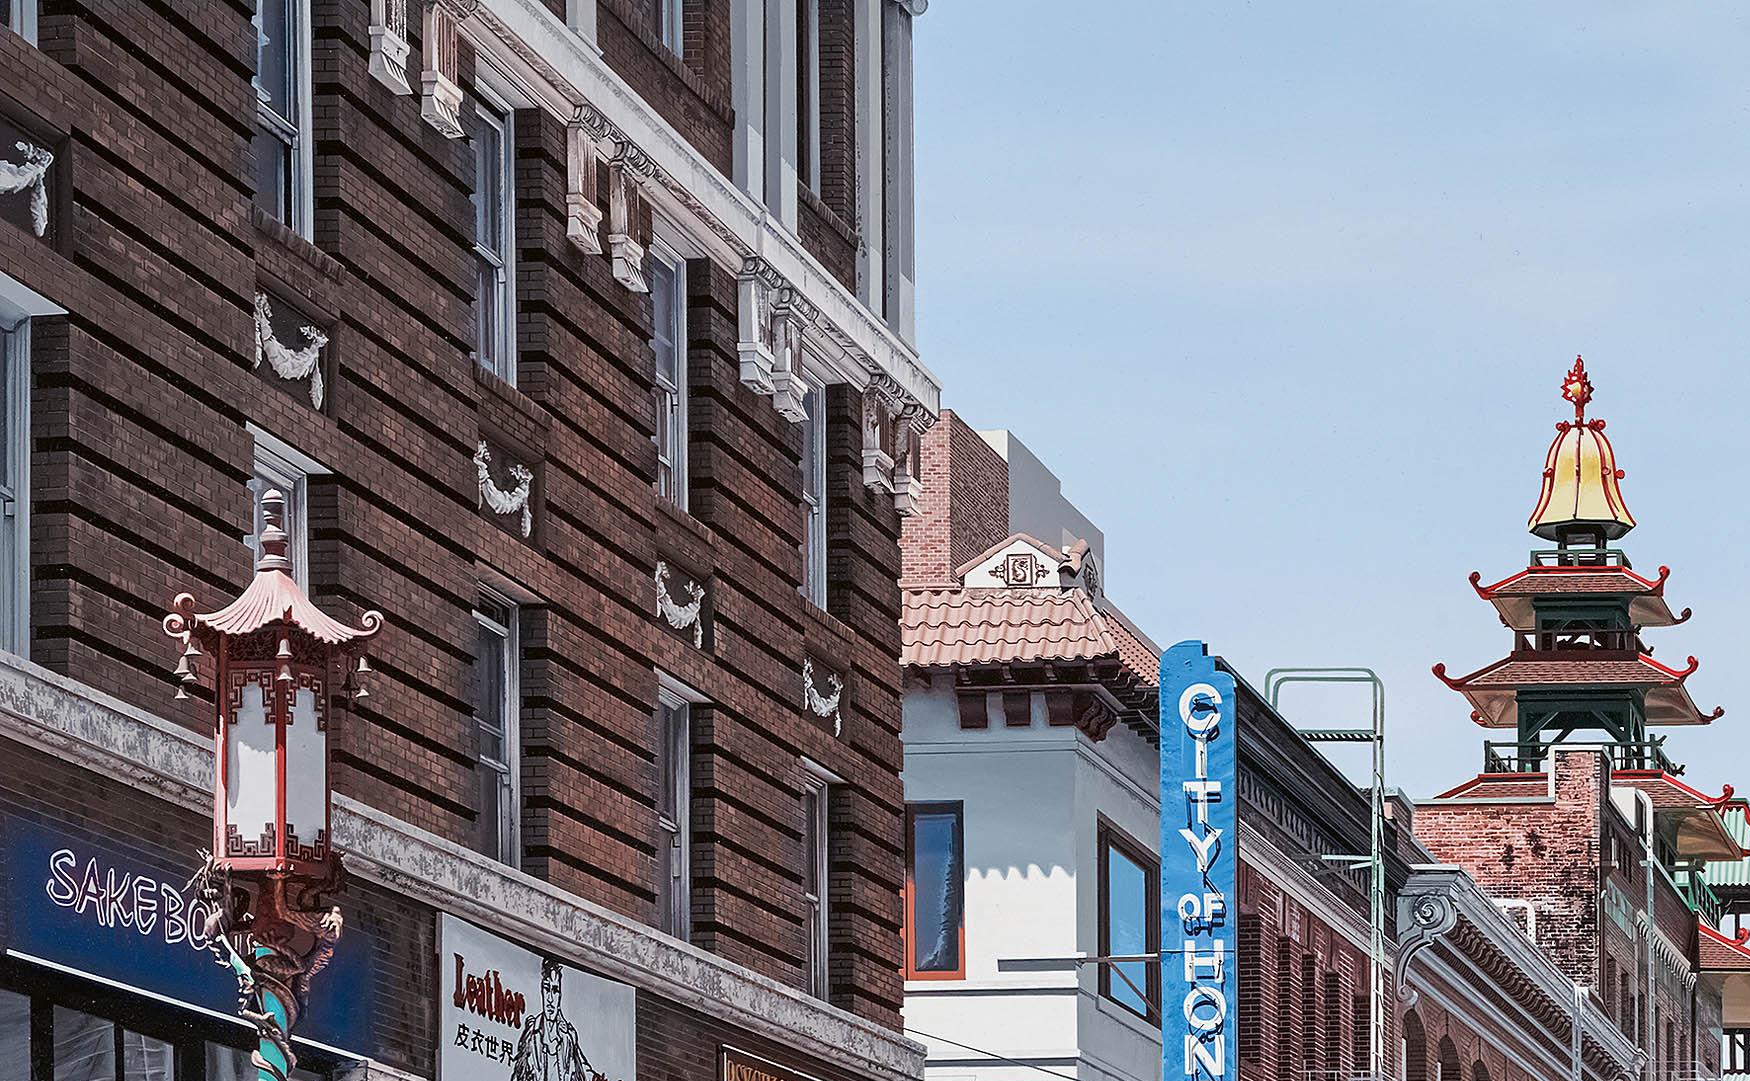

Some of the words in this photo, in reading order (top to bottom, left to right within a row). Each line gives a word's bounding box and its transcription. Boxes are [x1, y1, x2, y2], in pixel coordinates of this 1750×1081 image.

[1178, 683, 1223, 872] CITY
[1177, 892, 1224, 922] OF
[453, 953, 526, 1029] Leather
[454, 1023, 514, 1066] 皮衣世界
